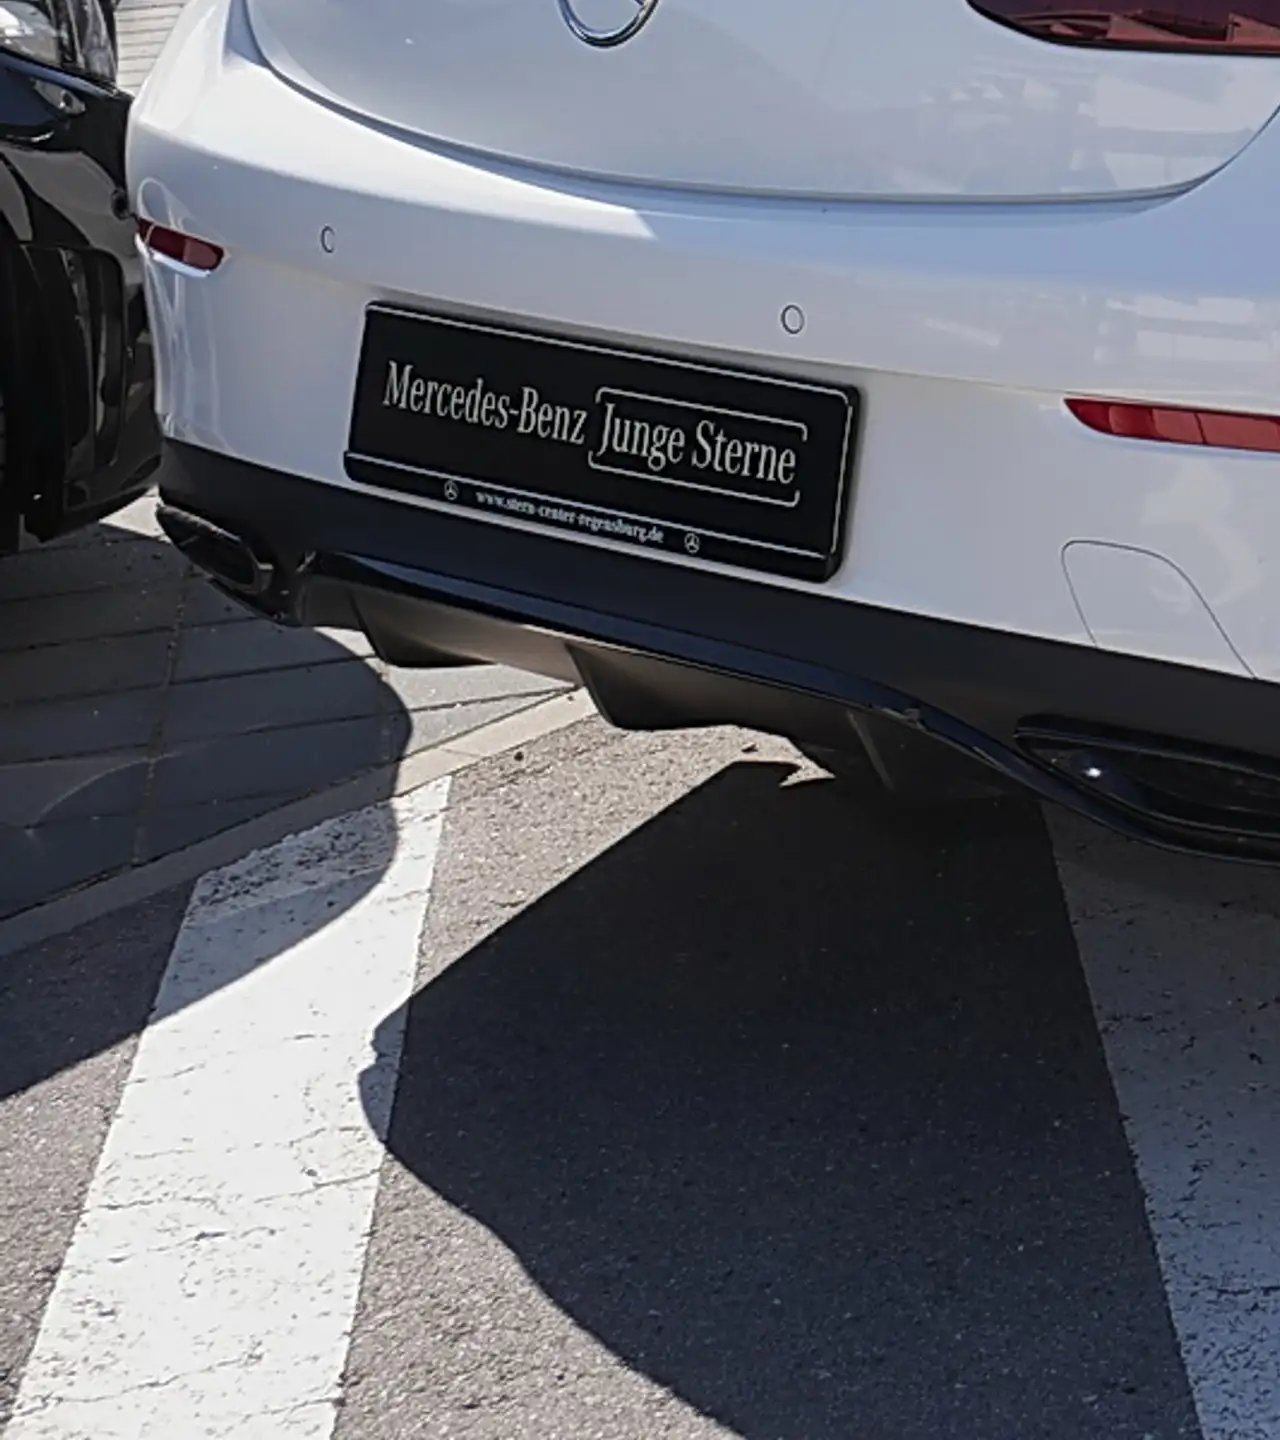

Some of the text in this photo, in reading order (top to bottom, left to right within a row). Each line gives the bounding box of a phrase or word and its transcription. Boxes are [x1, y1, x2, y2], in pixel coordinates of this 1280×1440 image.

[383, 361, 797, 485] Mercedes-Benz Junge Sterne
[475, 491, 664, 544] www.stern-center-regensburg.de
